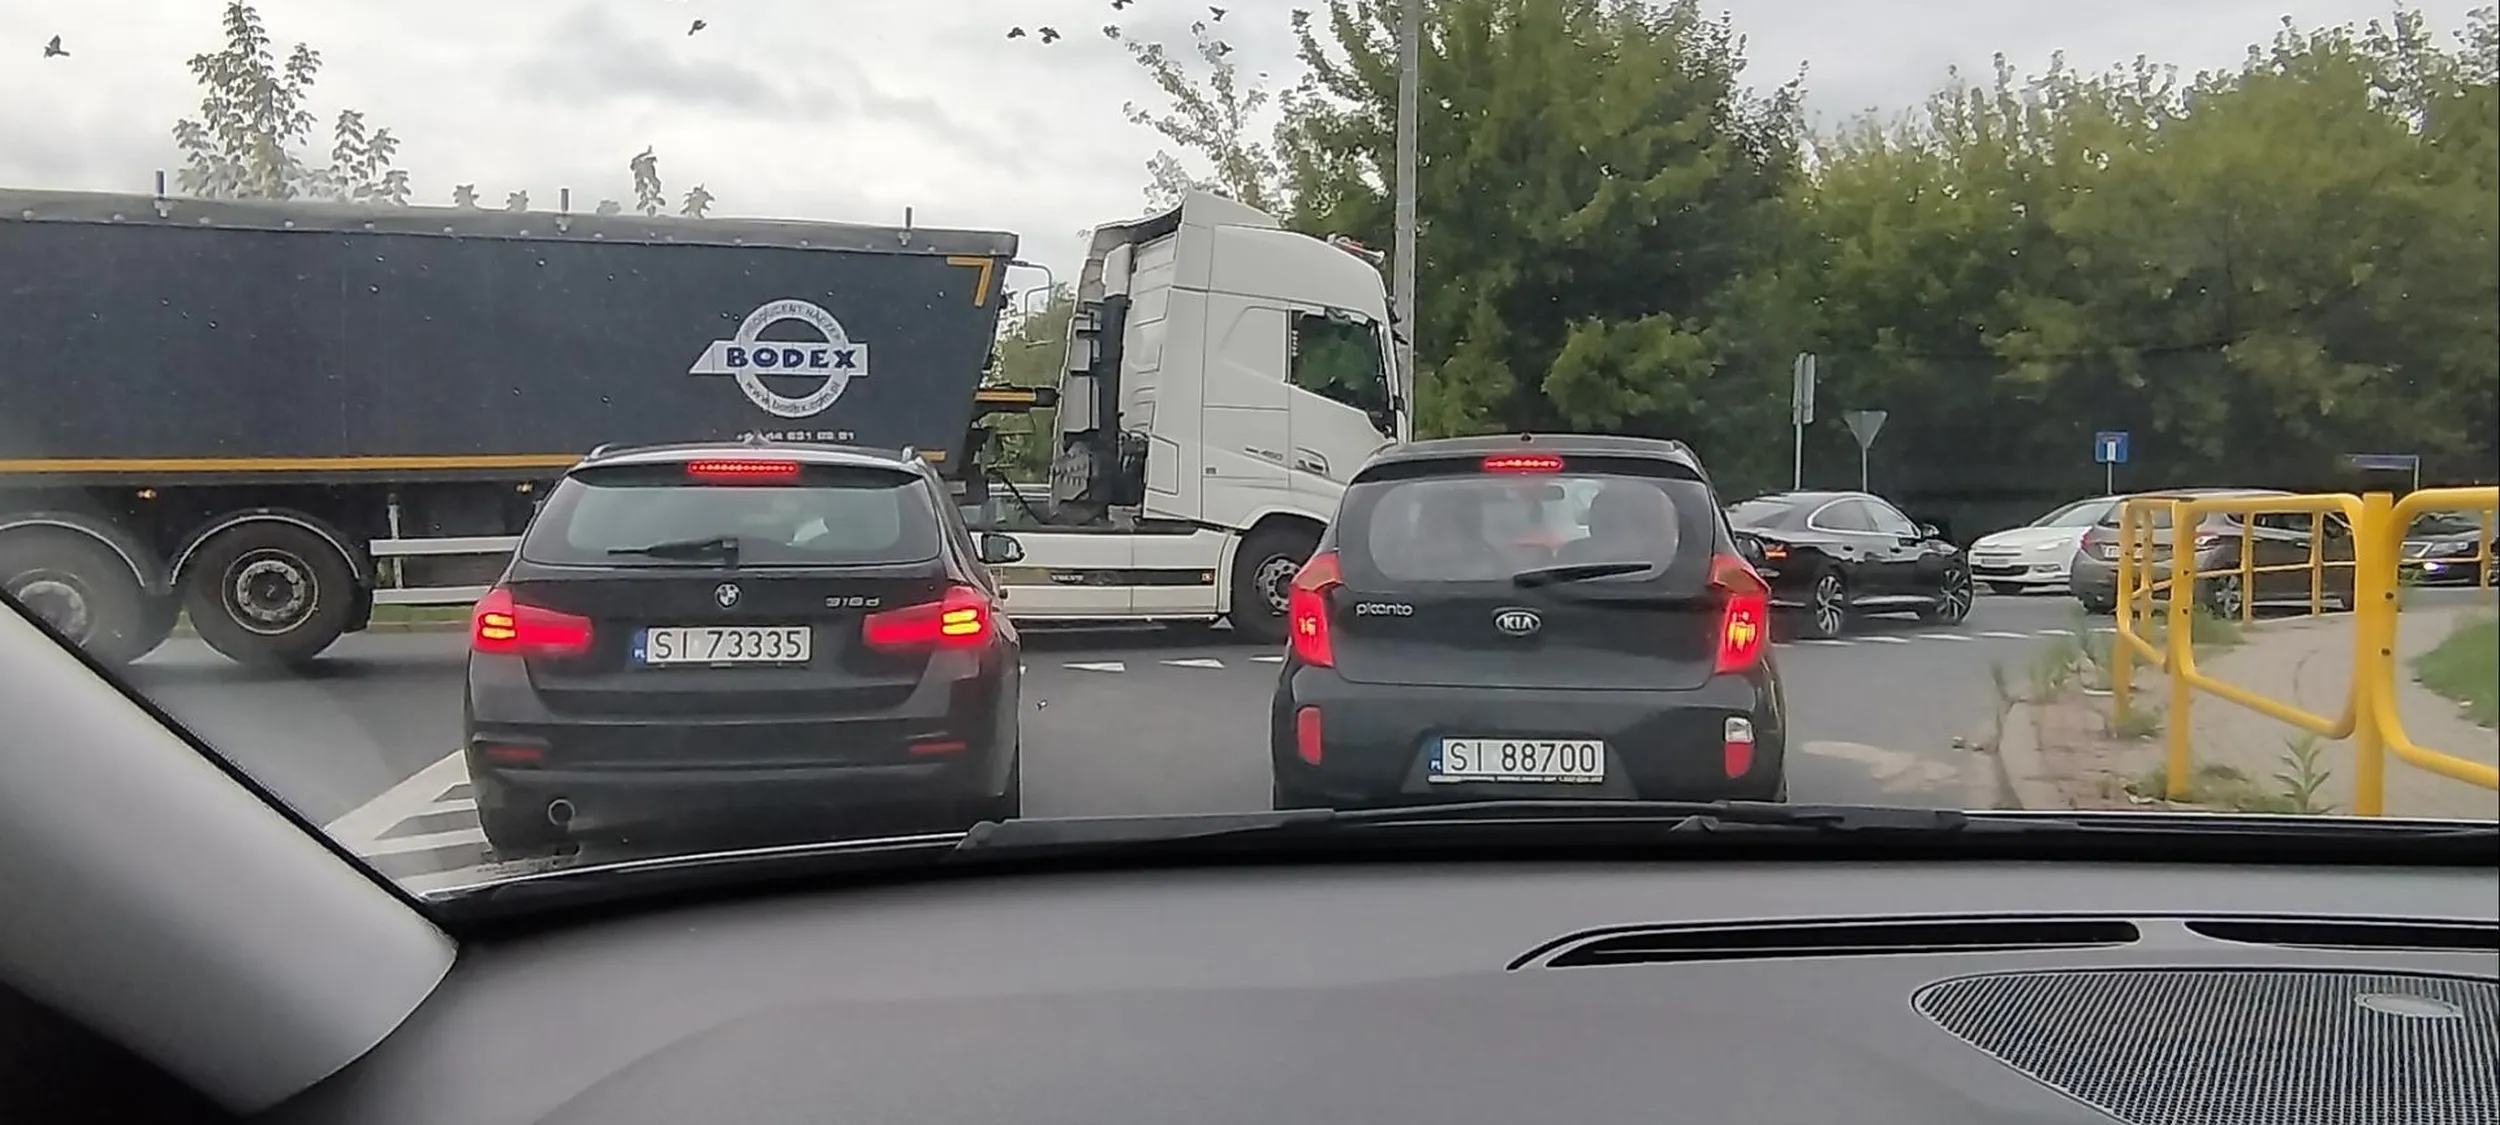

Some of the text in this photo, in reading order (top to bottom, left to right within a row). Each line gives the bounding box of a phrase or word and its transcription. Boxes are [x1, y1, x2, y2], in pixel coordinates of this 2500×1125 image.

[726, 347, 856, 369] BODEX
[825, 596, 880, 607] 318d
[1355, 602, 1413, 616] picanto
[1503, 615, 1534, 629] KIA
[654, 630, 803, 659] SI 73335
[1450, 742, 1597, 773] SI 88700
